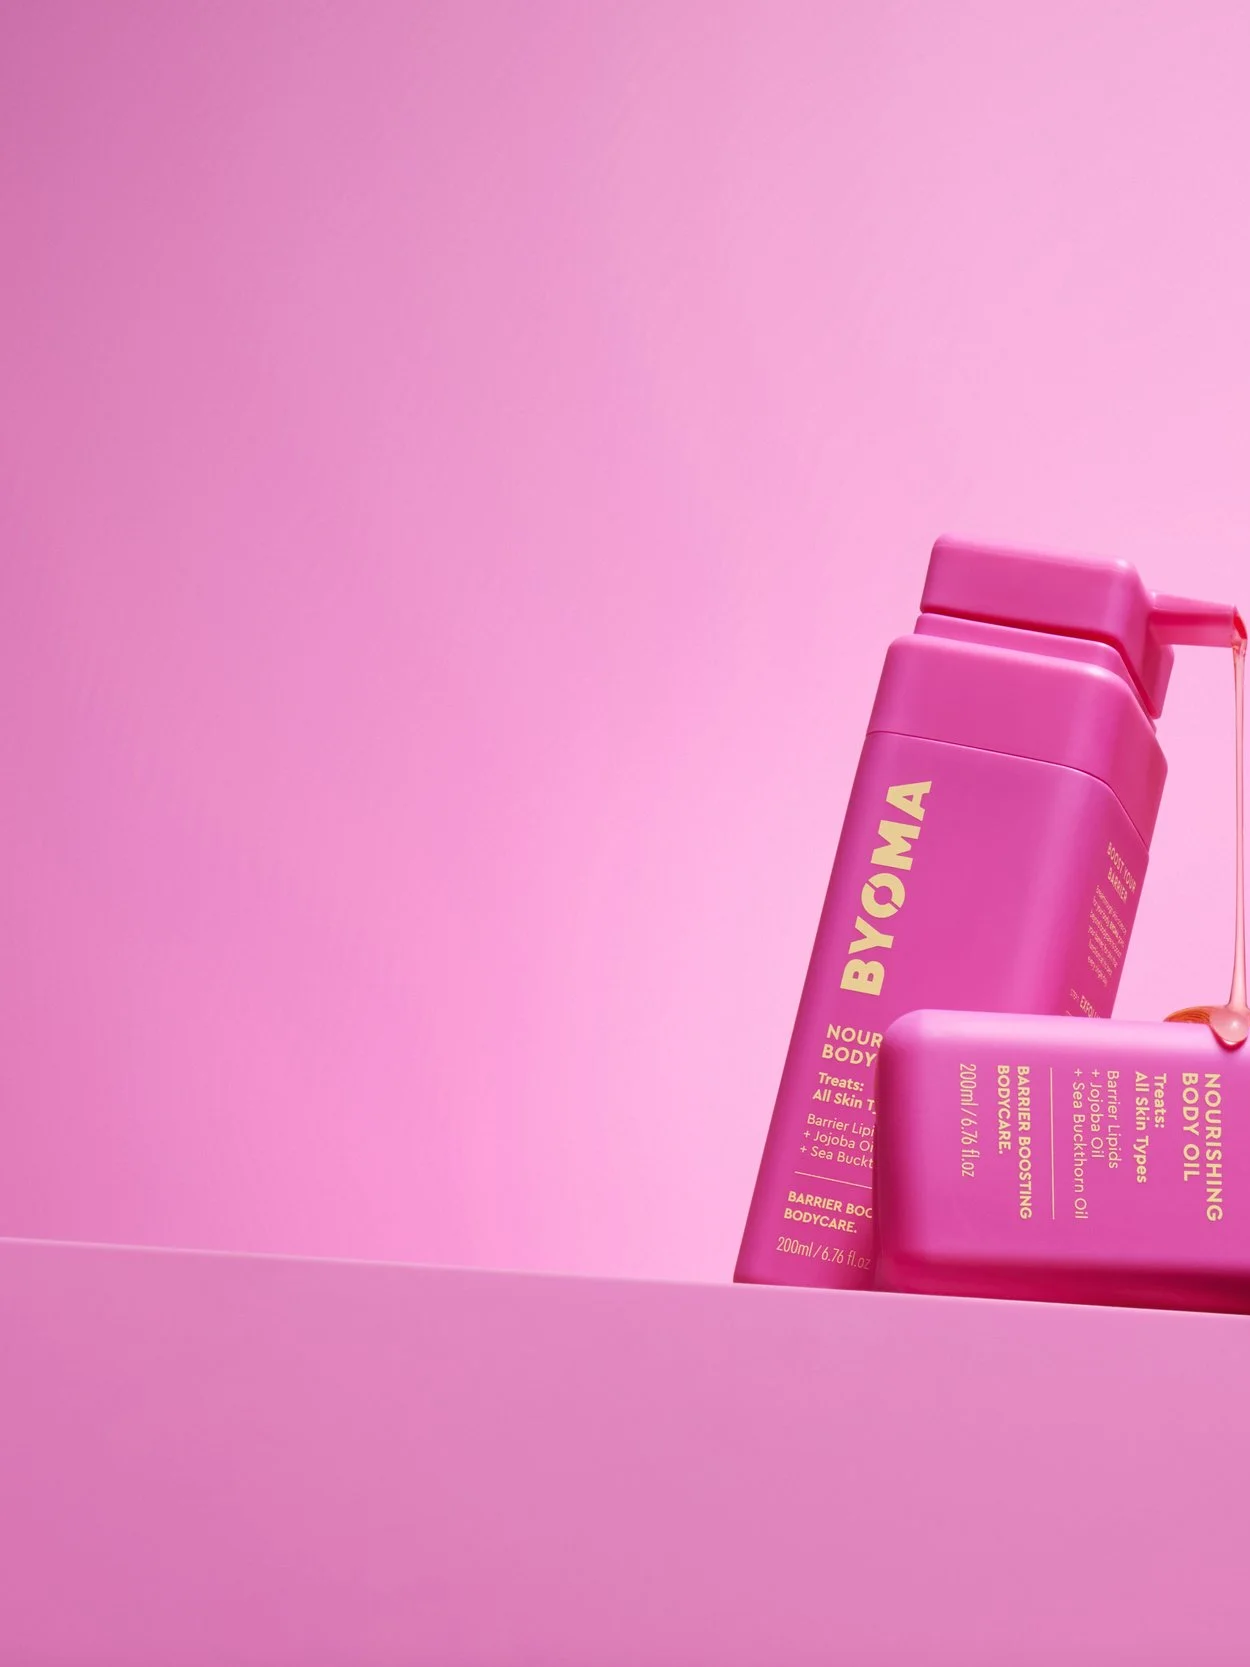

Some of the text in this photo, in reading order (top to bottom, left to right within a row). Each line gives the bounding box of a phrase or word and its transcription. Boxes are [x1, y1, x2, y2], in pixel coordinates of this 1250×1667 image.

[840, 780, 932, 996] BYOMA
[1106, 841, 1125, 874] BOOST
[1123, 868, 1137, 894] YOUR
[1107, 866, 1128, 904] BARRIER
[818, 1071, 865, 1092] Treats:
[821, 1043, 878, 1068] BODY
[807, 1113, 850, 1132] Barrier
[812, 1088, 832, 1103] All
[833, 1092, 863, 1109] Skin
[997, 1064, 1012, 1155] BODYCARE.
[1088, 1068, 1105, 1159] + Jojoba Oil
[1106, 1070, 1123, 1169] Barrier Lipids
[1153, 1073, 1167, 1129] Treats:
[800, 1145, 808, 1154] +
[810, 1145, 833, 1161] Sea
[803, 1130, 811, 1139] +
[813, 1130, 856, 1150] Jojoba
[1017, 1065, 1033, 1219] BARRIER BOOSTING
[1072, 1068, 1089, 1219] + Sea Buckthorn Oil
[1133, 1071, 1151, 1184] All Skin Types
[1182, 1072, 1201, 1182] BODY OIL
[1204, 1073, 1223, 1222] NOURISHING
[961, 1149, 981, 1178] fl.oz
[783, 1207, 858, 1234] BODYCARE.
[787, 1190, 843, 1213] BARRIER
